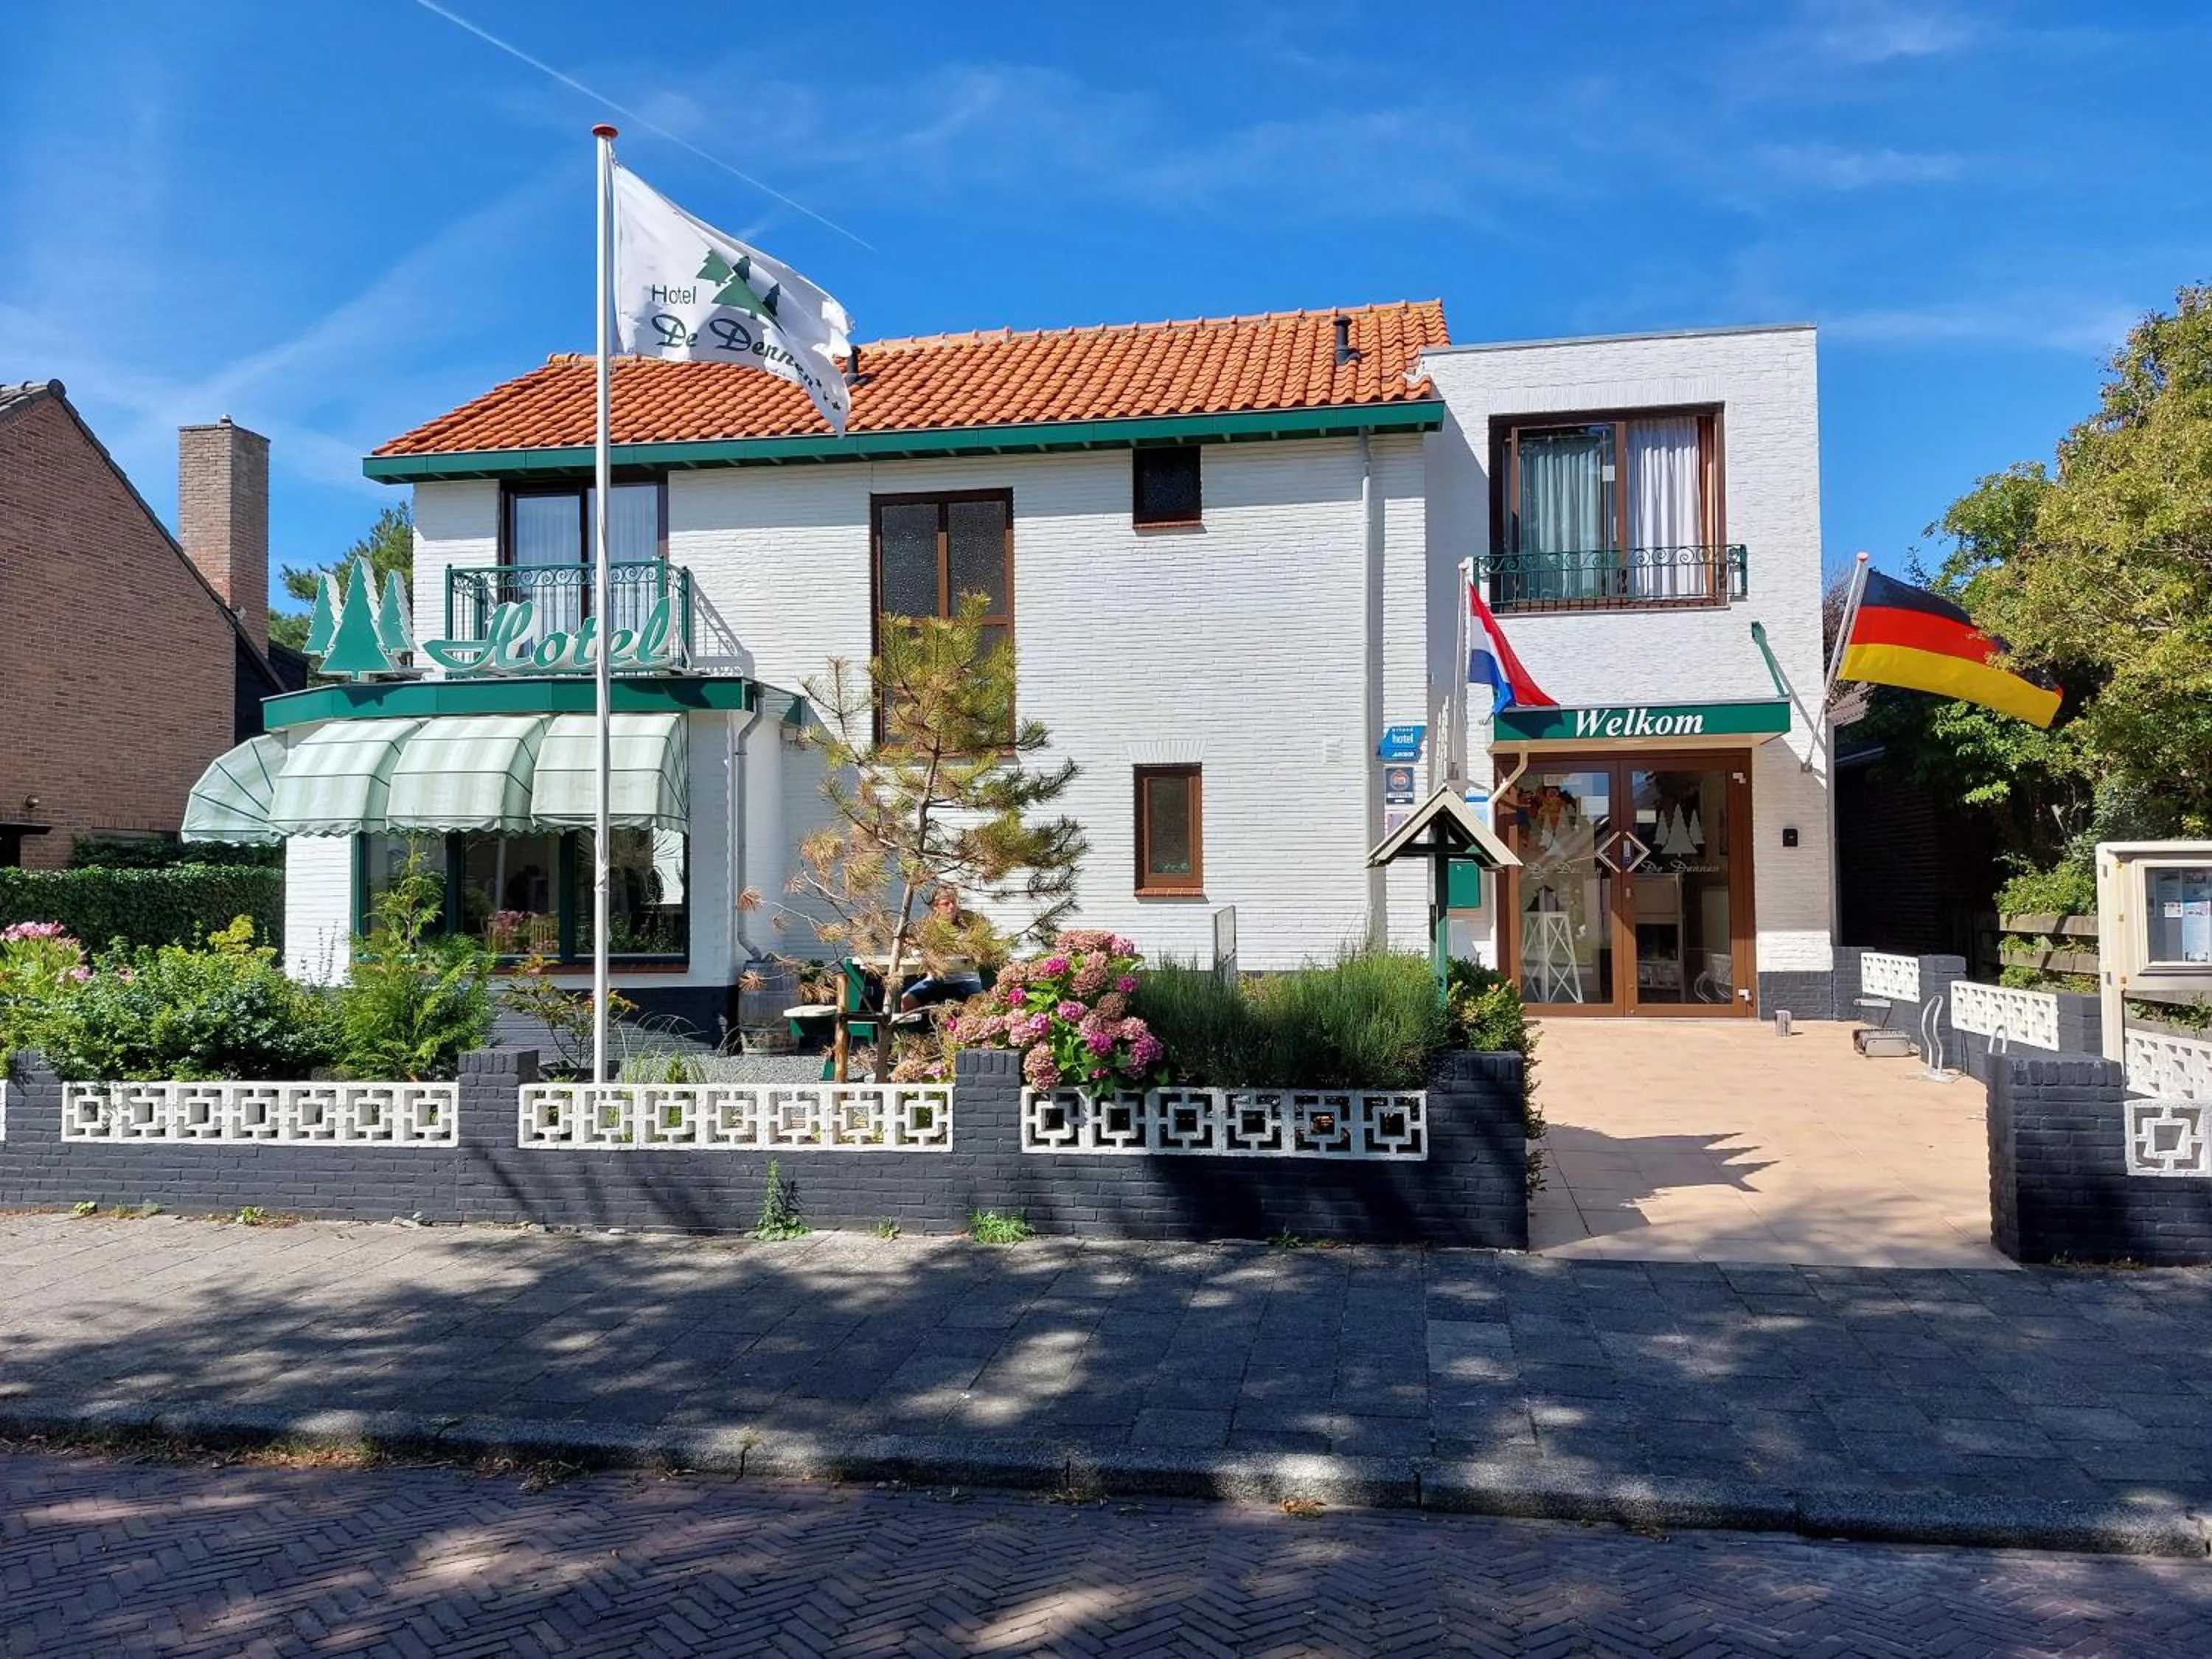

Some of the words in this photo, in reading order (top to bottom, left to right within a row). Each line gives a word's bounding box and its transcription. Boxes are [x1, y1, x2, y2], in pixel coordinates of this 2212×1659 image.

[651, 284, 698, 305] Hotel
[650, 313, 699, 349] De
[422, 596, 678, 670] Hotel
[1576, 707, 1704, 737] Welkom
[1391, 732, 1413, 744] hotel
